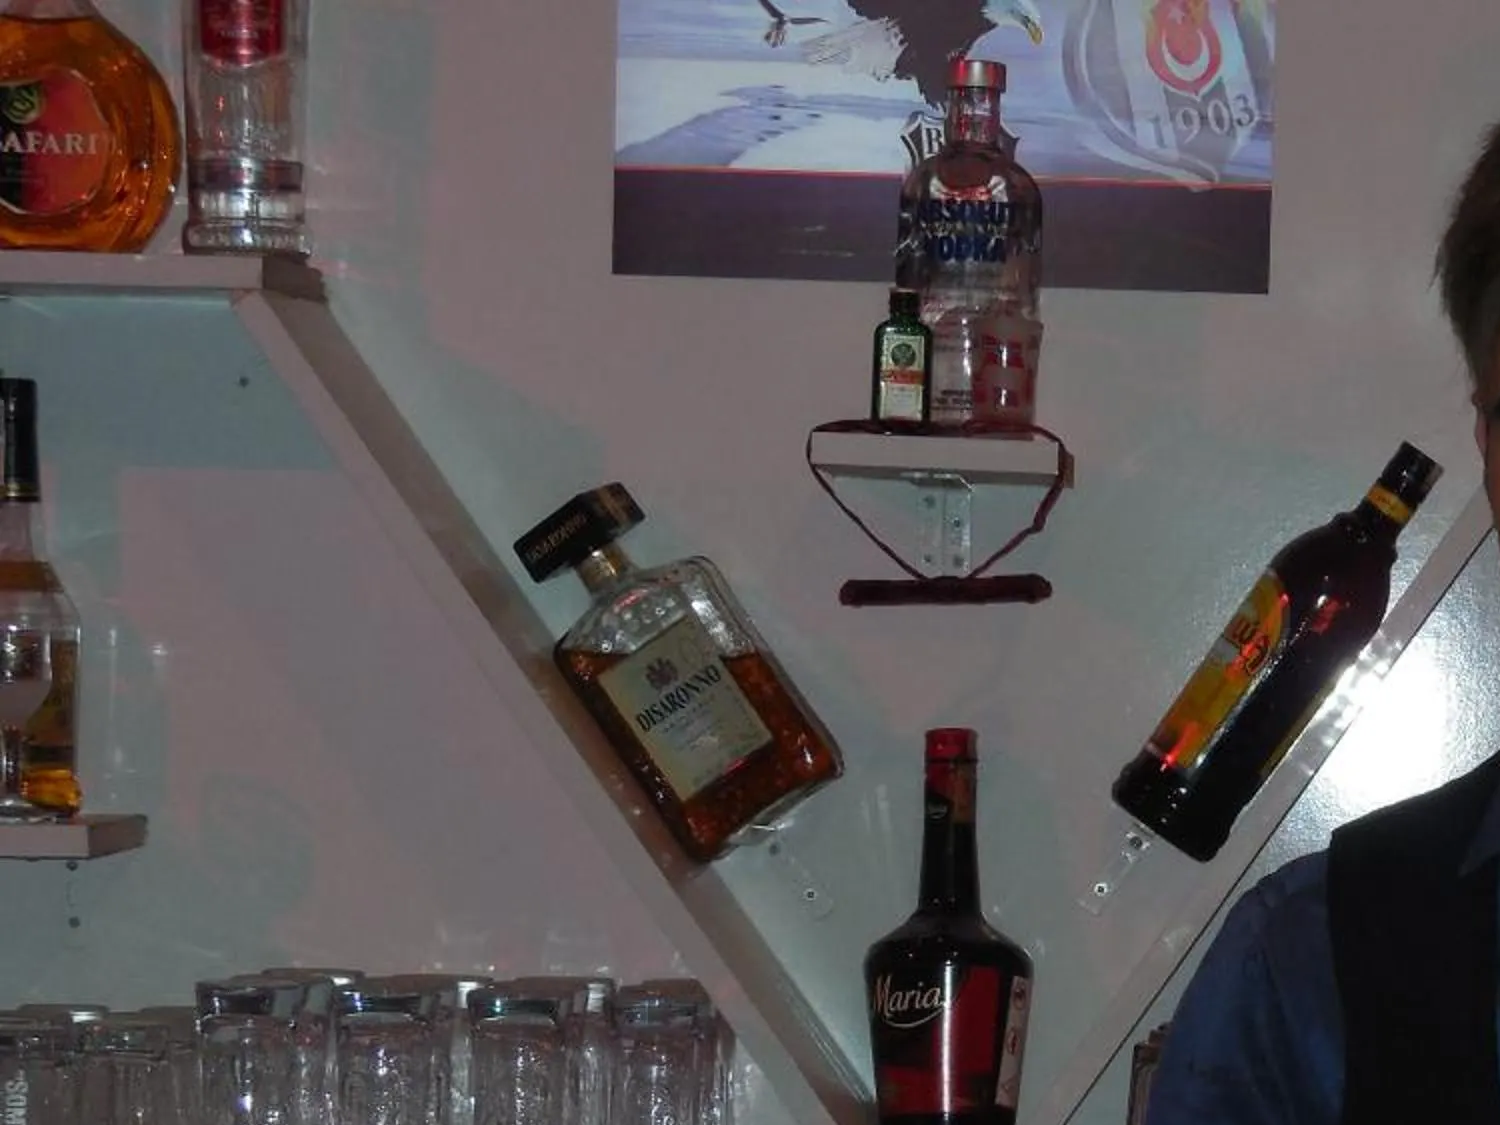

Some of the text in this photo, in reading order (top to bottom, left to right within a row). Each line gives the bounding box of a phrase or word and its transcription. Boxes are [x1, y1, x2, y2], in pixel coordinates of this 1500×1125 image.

[0, 130, 98, 156] AFARI
[1147, 93, 1256, 149] 1903
[635, 664, 722, 733] DISARONNO
[873, 974, 945, 1027] Maria
